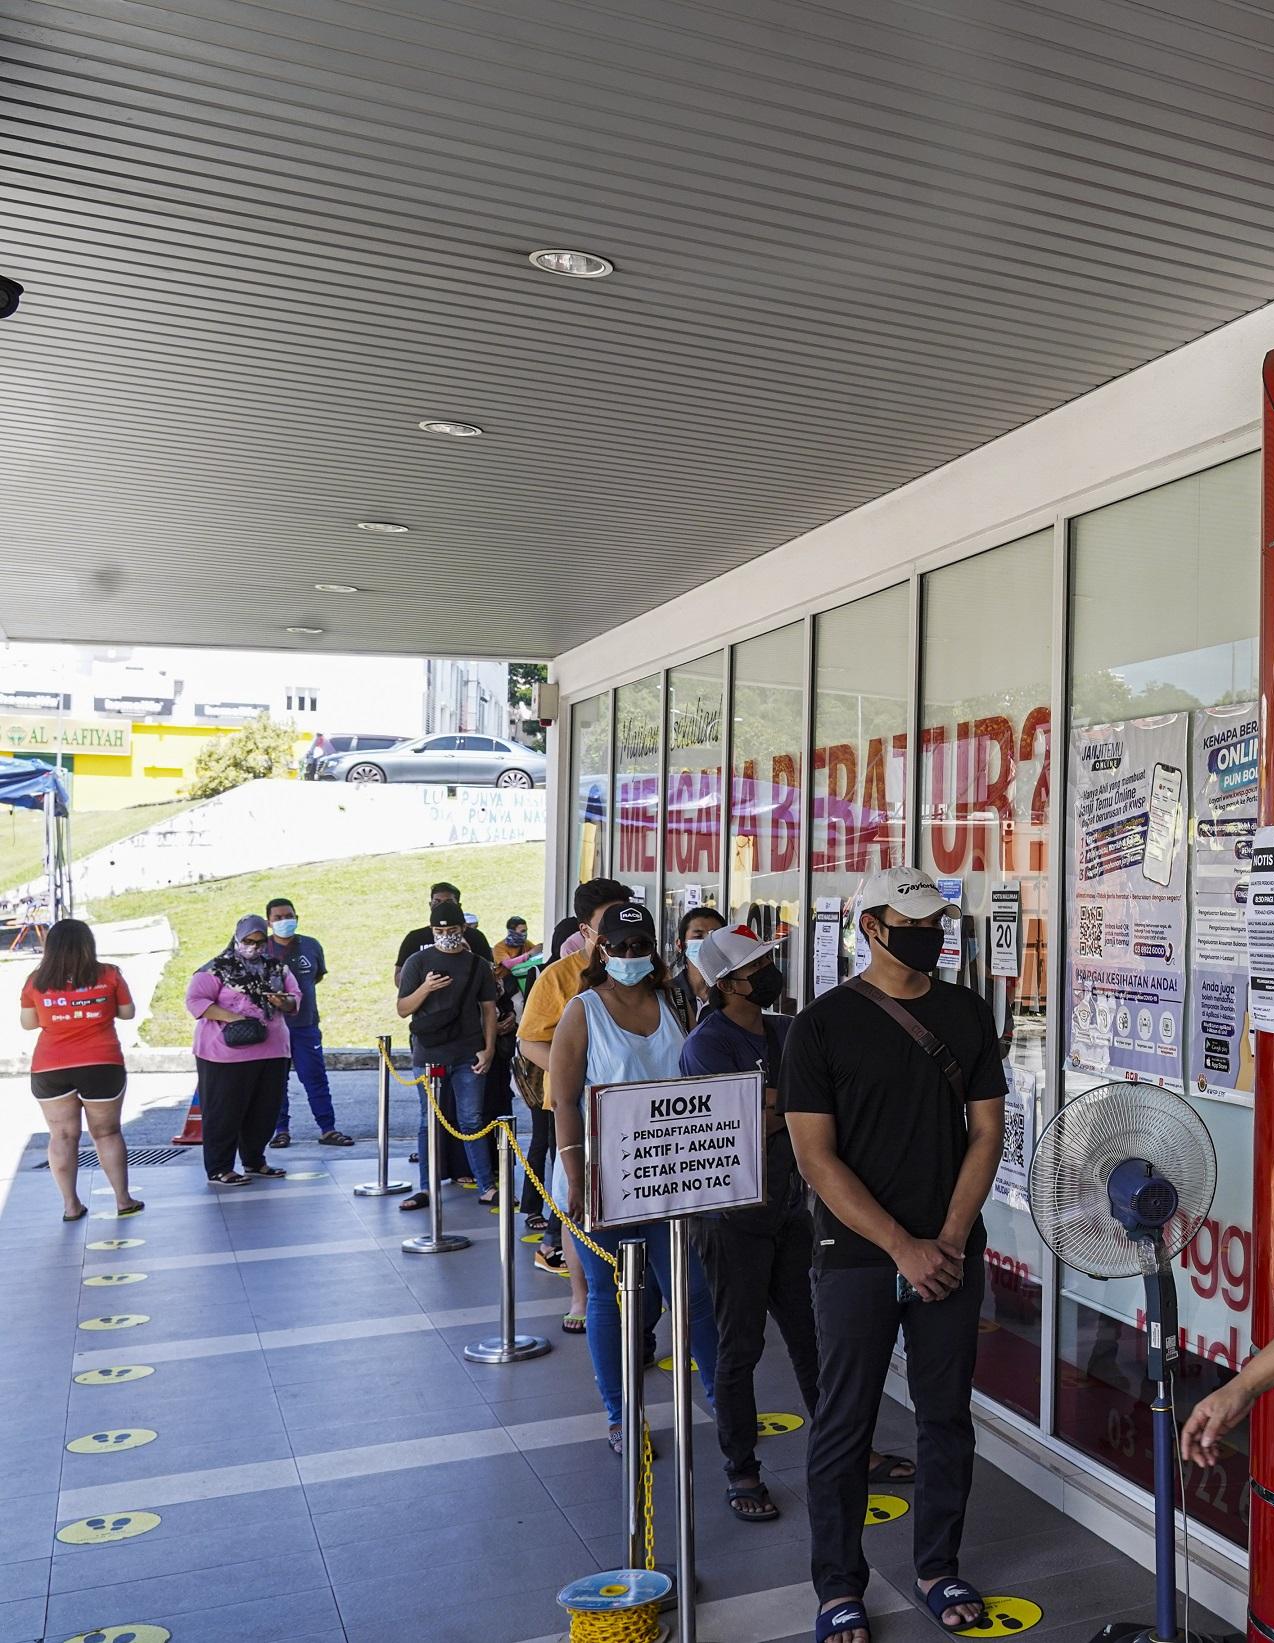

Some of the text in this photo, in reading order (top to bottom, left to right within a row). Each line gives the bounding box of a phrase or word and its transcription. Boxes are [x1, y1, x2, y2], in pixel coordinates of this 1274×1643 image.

[1203, 720, 1259, 750] KENAPA BER
[1223, 772, 1241, 788] PUN
[1114, 787, 1136, 805] Online
[1129, 796, 1146, 811] KWSP
[1253, 854, 1274, 866] NOTIS
[996, 924, 1012, 949] 20
[1151, 947, 1165, 955] 6000
[1106, 971, 1149, 989] KESIHATAN
[1150, 976, 1178, 992] ANDA!
[1201, 981, 1235, 998] Anda juga
[650, 1094, 712, 1118] KIOSK
[633, 1119, 741, 1141] PENDAFTARAN AHLI
[633, 1143, 672, 1160] AKTIF
[688, 1135, 736, 1153] AKAUN
[633, 1153, 741, 1180] CETAK PENYATA
[633, 1174, 731, 1200] TUKAR NO TAC
